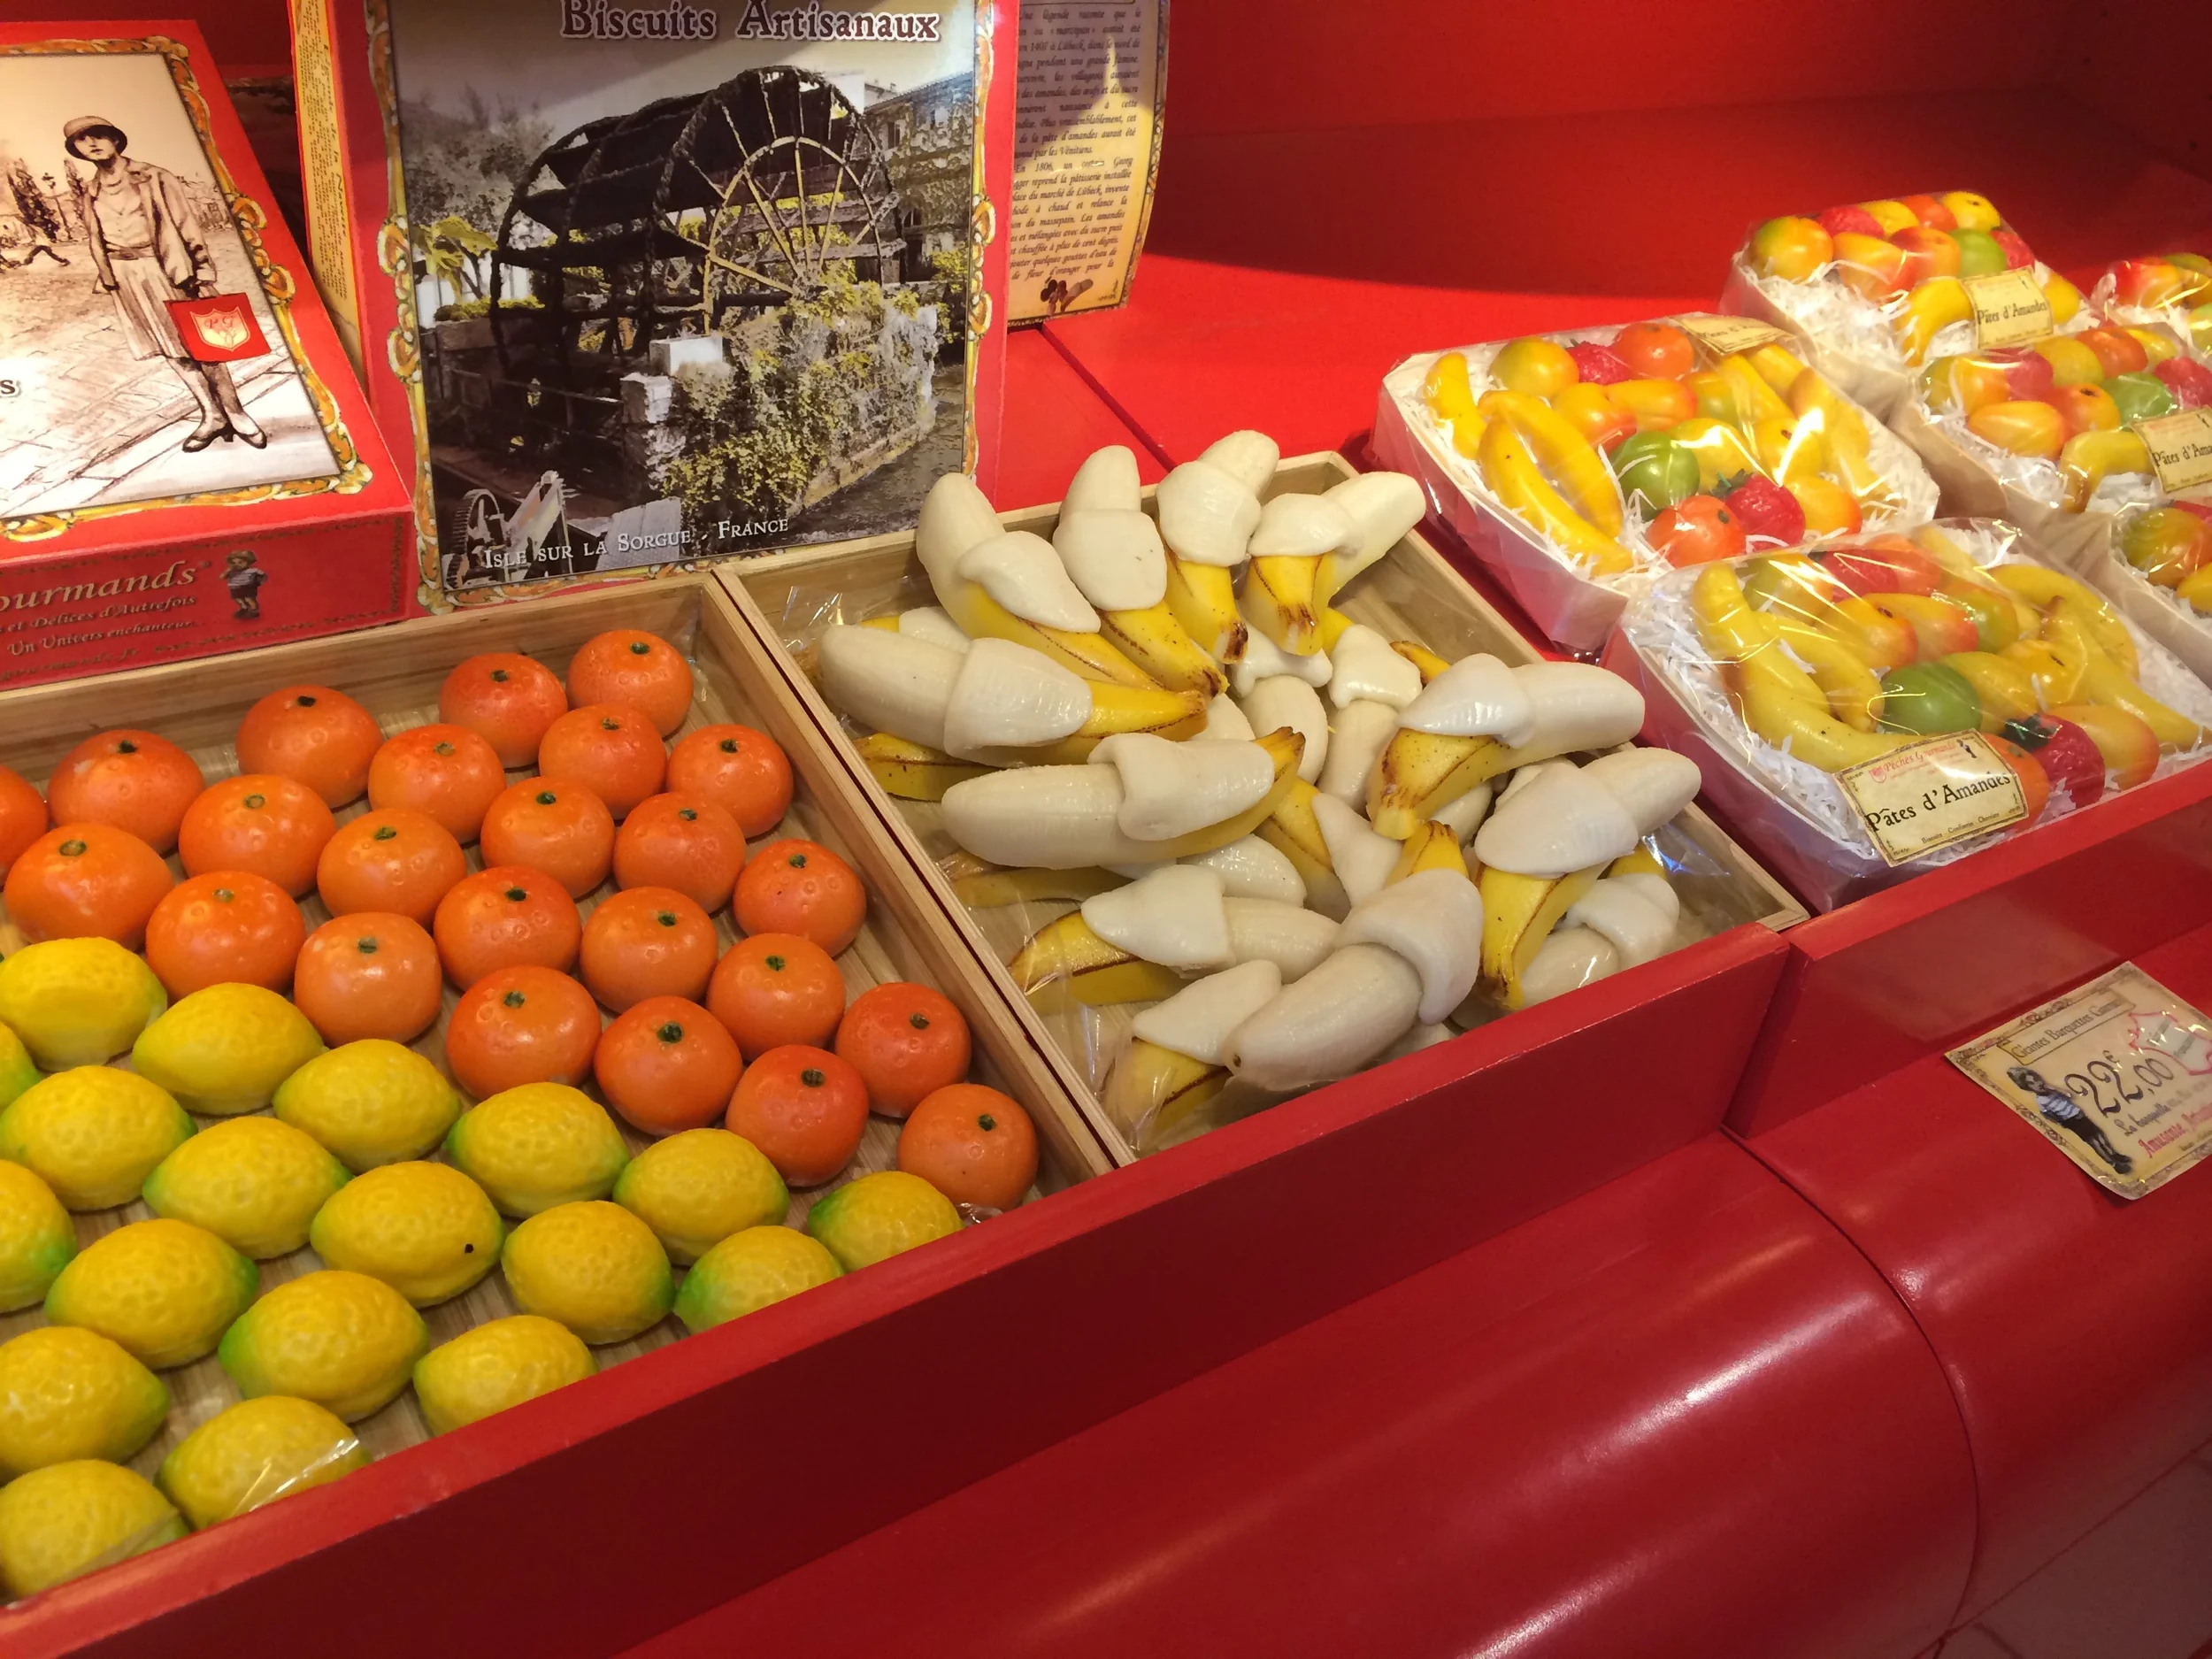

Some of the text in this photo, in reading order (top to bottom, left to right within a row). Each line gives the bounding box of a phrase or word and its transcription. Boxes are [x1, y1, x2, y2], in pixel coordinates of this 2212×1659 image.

[560, 0, 942, 42] Biscuits Artisanaux
[1033, 178, 1057, 188] reprend
[1029, 191, 1037, 201] du
[1066, 188, 1074, 197] de
[1048, 203, 1070, 212] chaud
[1026, 218, 1035, 227] du
[1080, 213, 1093, 222] Les
[1080, 227, 1088, 235] du
[0, 560, 196, 611] ourmands
[7, 641, 35, 656] Un
[42, 632, 103, 649] Univers
[1864, 805, 1917, 833] Pâtes
[1923, 771, 2010, 810] d'Amandes
